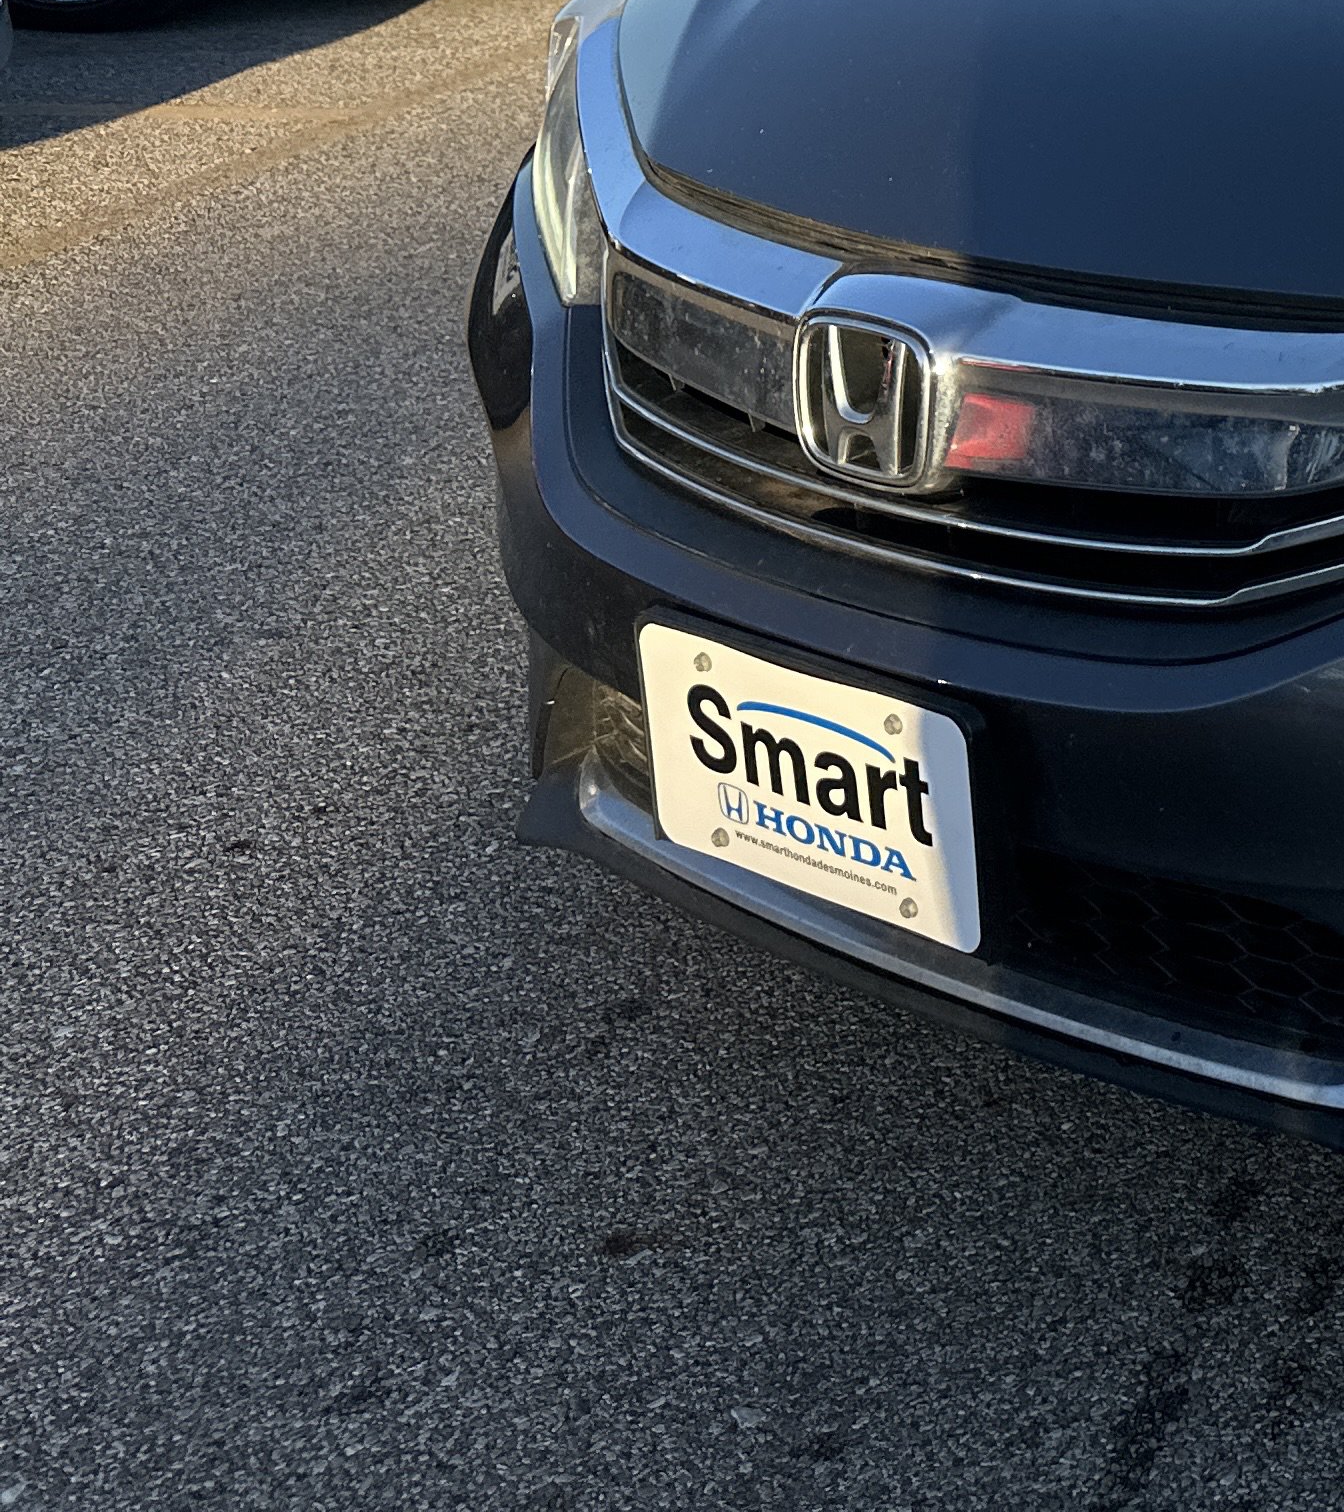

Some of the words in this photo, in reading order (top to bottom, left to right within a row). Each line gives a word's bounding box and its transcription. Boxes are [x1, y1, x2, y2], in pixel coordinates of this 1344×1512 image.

[687, 683, 933, 847] Smart
[735, 829, 898, 896] www.smarthondadesmoines.com
[753, 799, 917, 882] HONDA
